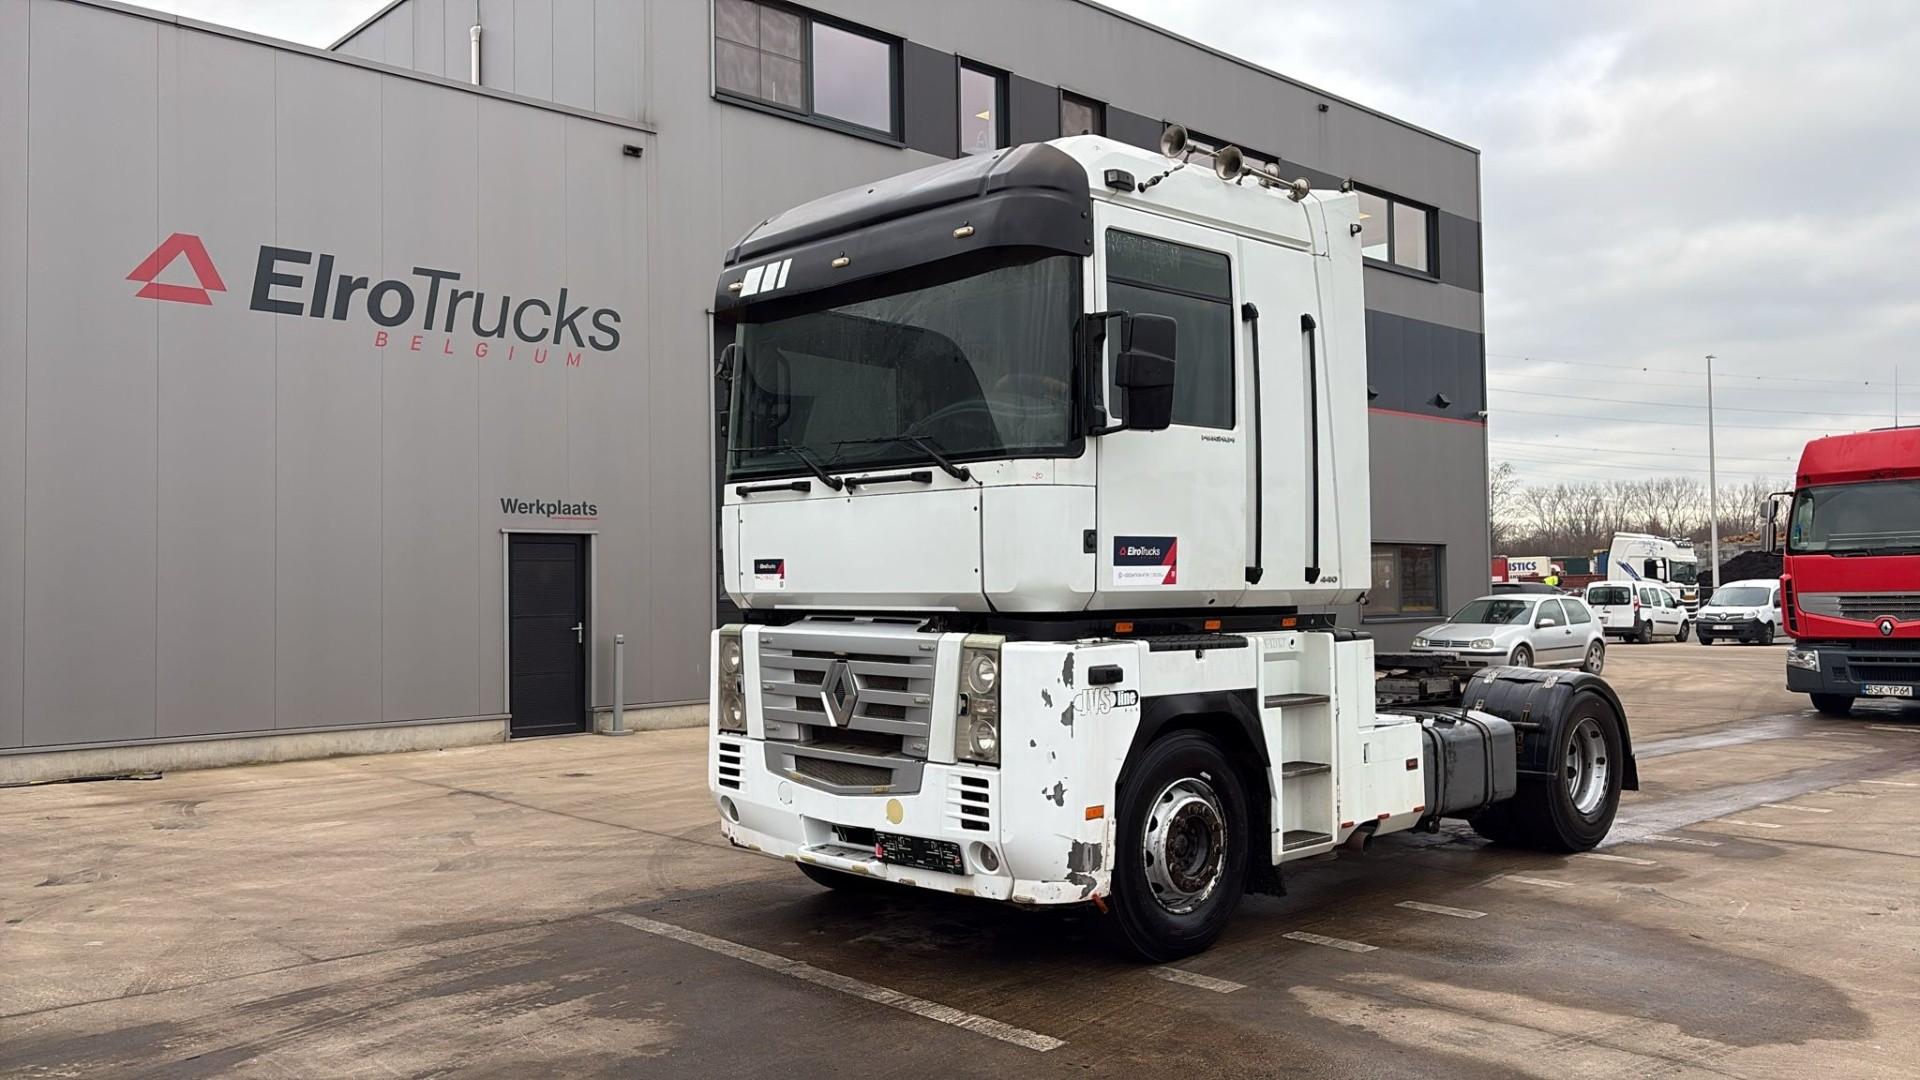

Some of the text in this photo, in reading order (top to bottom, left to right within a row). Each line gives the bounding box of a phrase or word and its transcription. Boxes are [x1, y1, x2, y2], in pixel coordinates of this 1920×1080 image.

[249, 245, 622, 352] ElroTrucks
[374, 331, 582, 368] BELGIUM
[500, 497, 598, 518] Werkplaats
[1127, 546, 1161, 555] ElroTrucks
